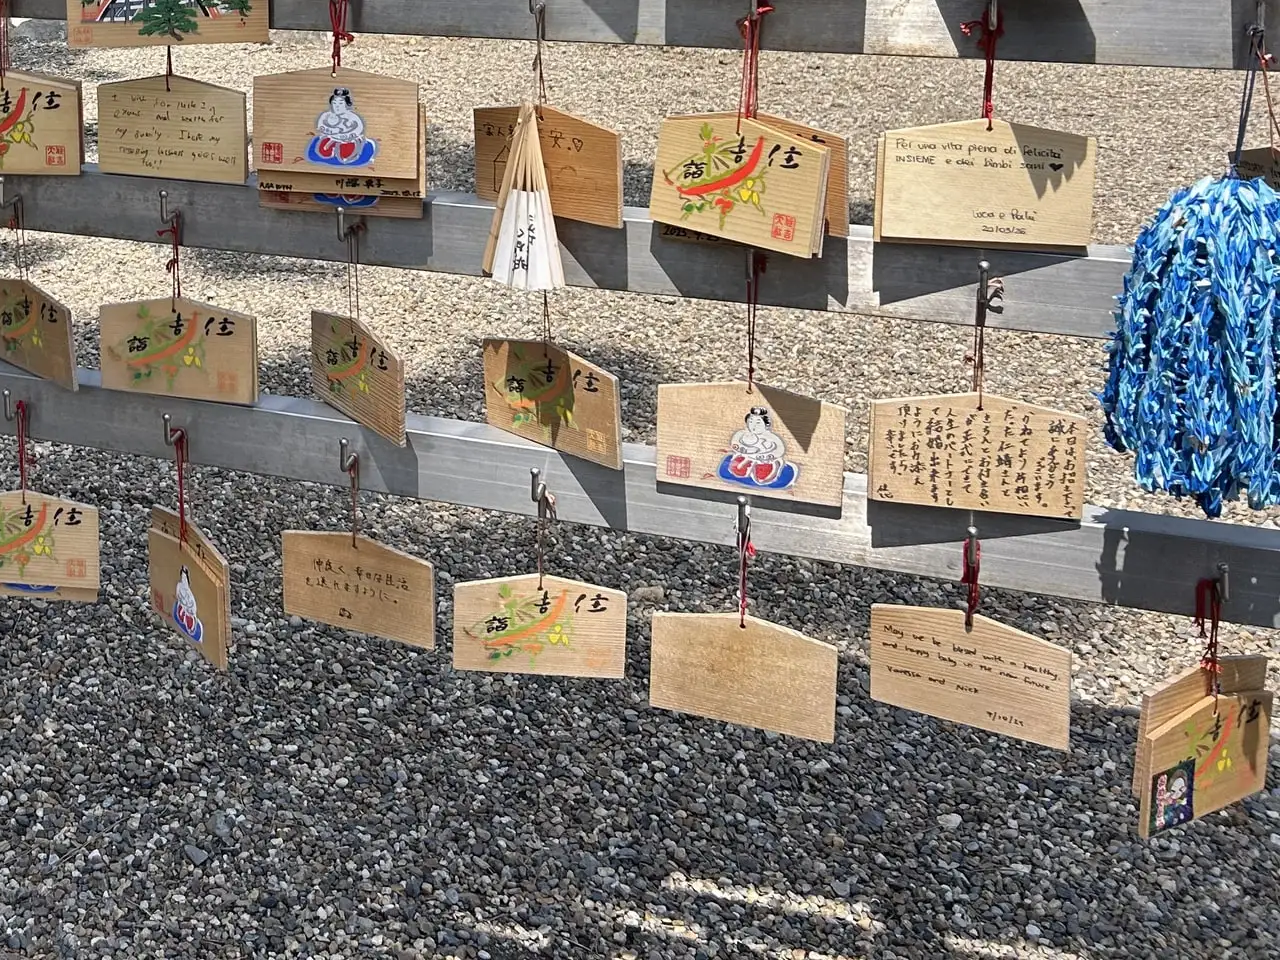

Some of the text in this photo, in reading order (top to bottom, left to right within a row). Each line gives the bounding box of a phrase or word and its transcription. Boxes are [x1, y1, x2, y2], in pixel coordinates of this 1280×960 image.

[896, 138, 912, 149] Per
[918, 141, 936, 150] una
[941, 141, 962, 150] vita
[968, 143, 997, 158] piena
[1004, 143, 1016, 155] di
[896, 155, 935, 165] INSIEME
[883, 624, 904, 640] May
